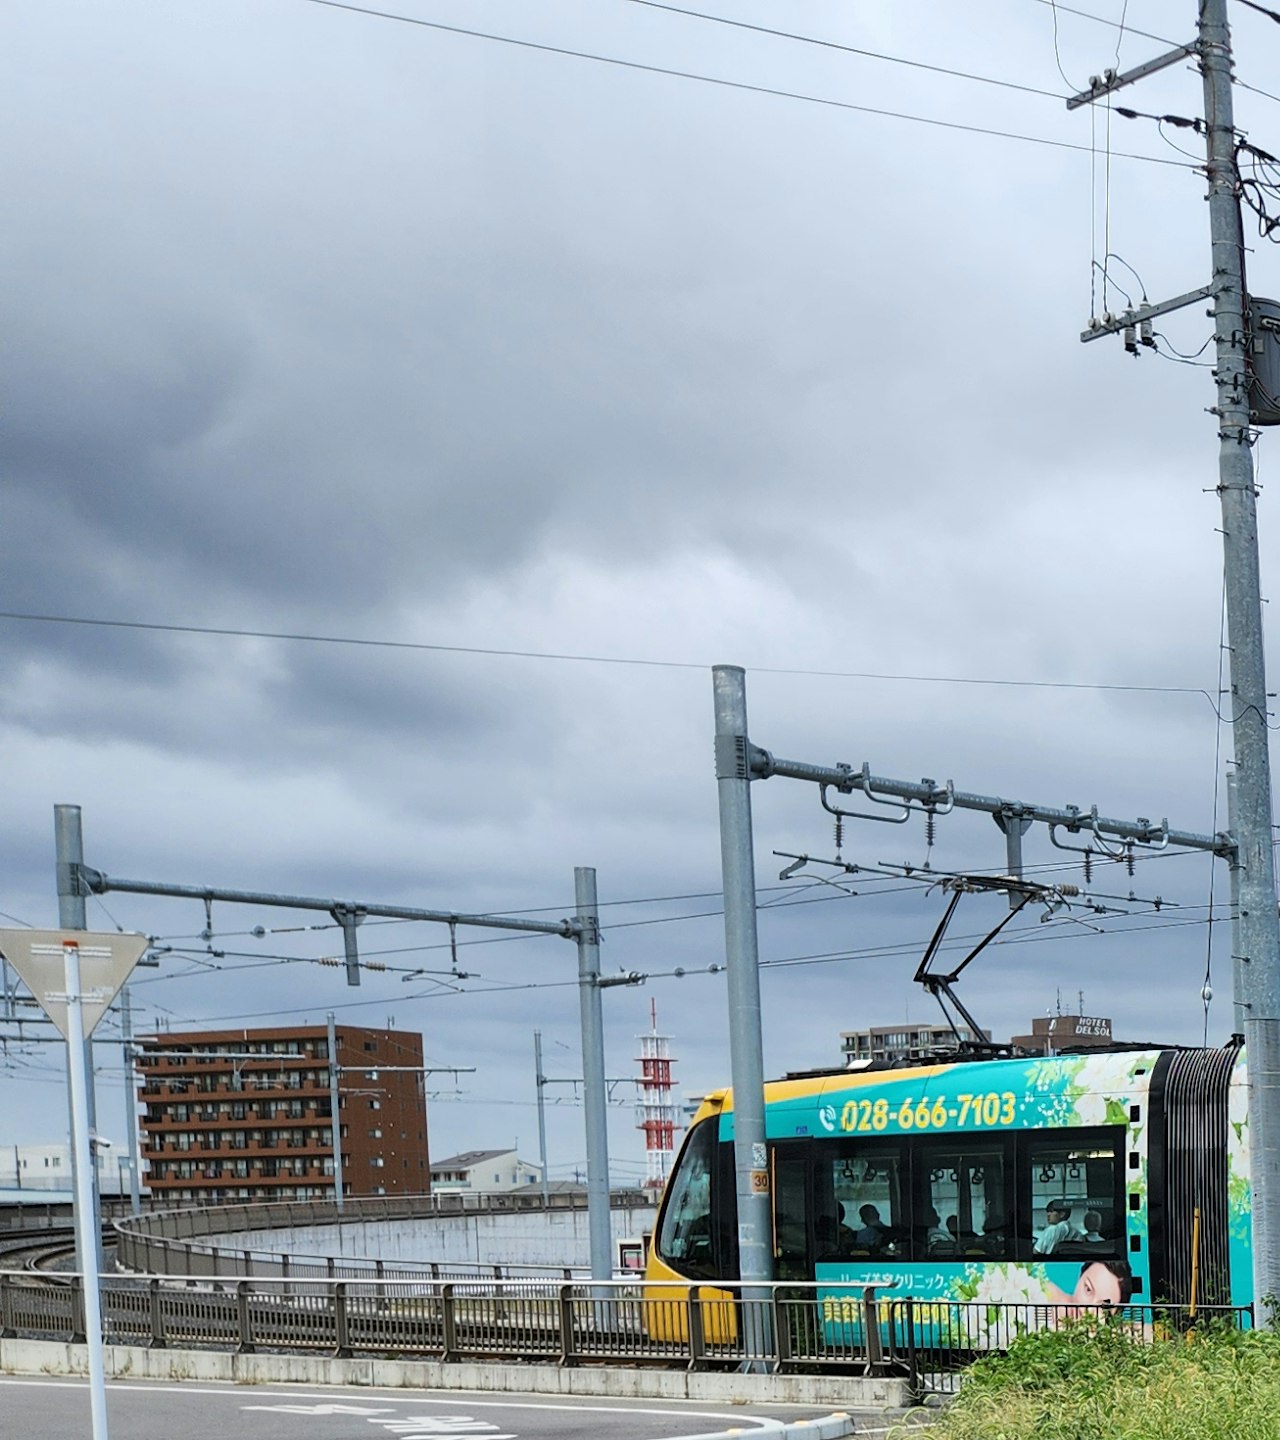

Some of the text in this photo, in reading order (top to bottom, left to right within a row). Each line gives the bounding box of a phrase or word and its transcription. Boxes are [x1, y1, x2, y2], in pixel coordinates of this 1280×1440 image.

[1079, 1017, 1107, 1028] HOTEL
[840, 1092, 1016, 1132] 028-666-7103
[754, 1174, 768, 1188] 30
